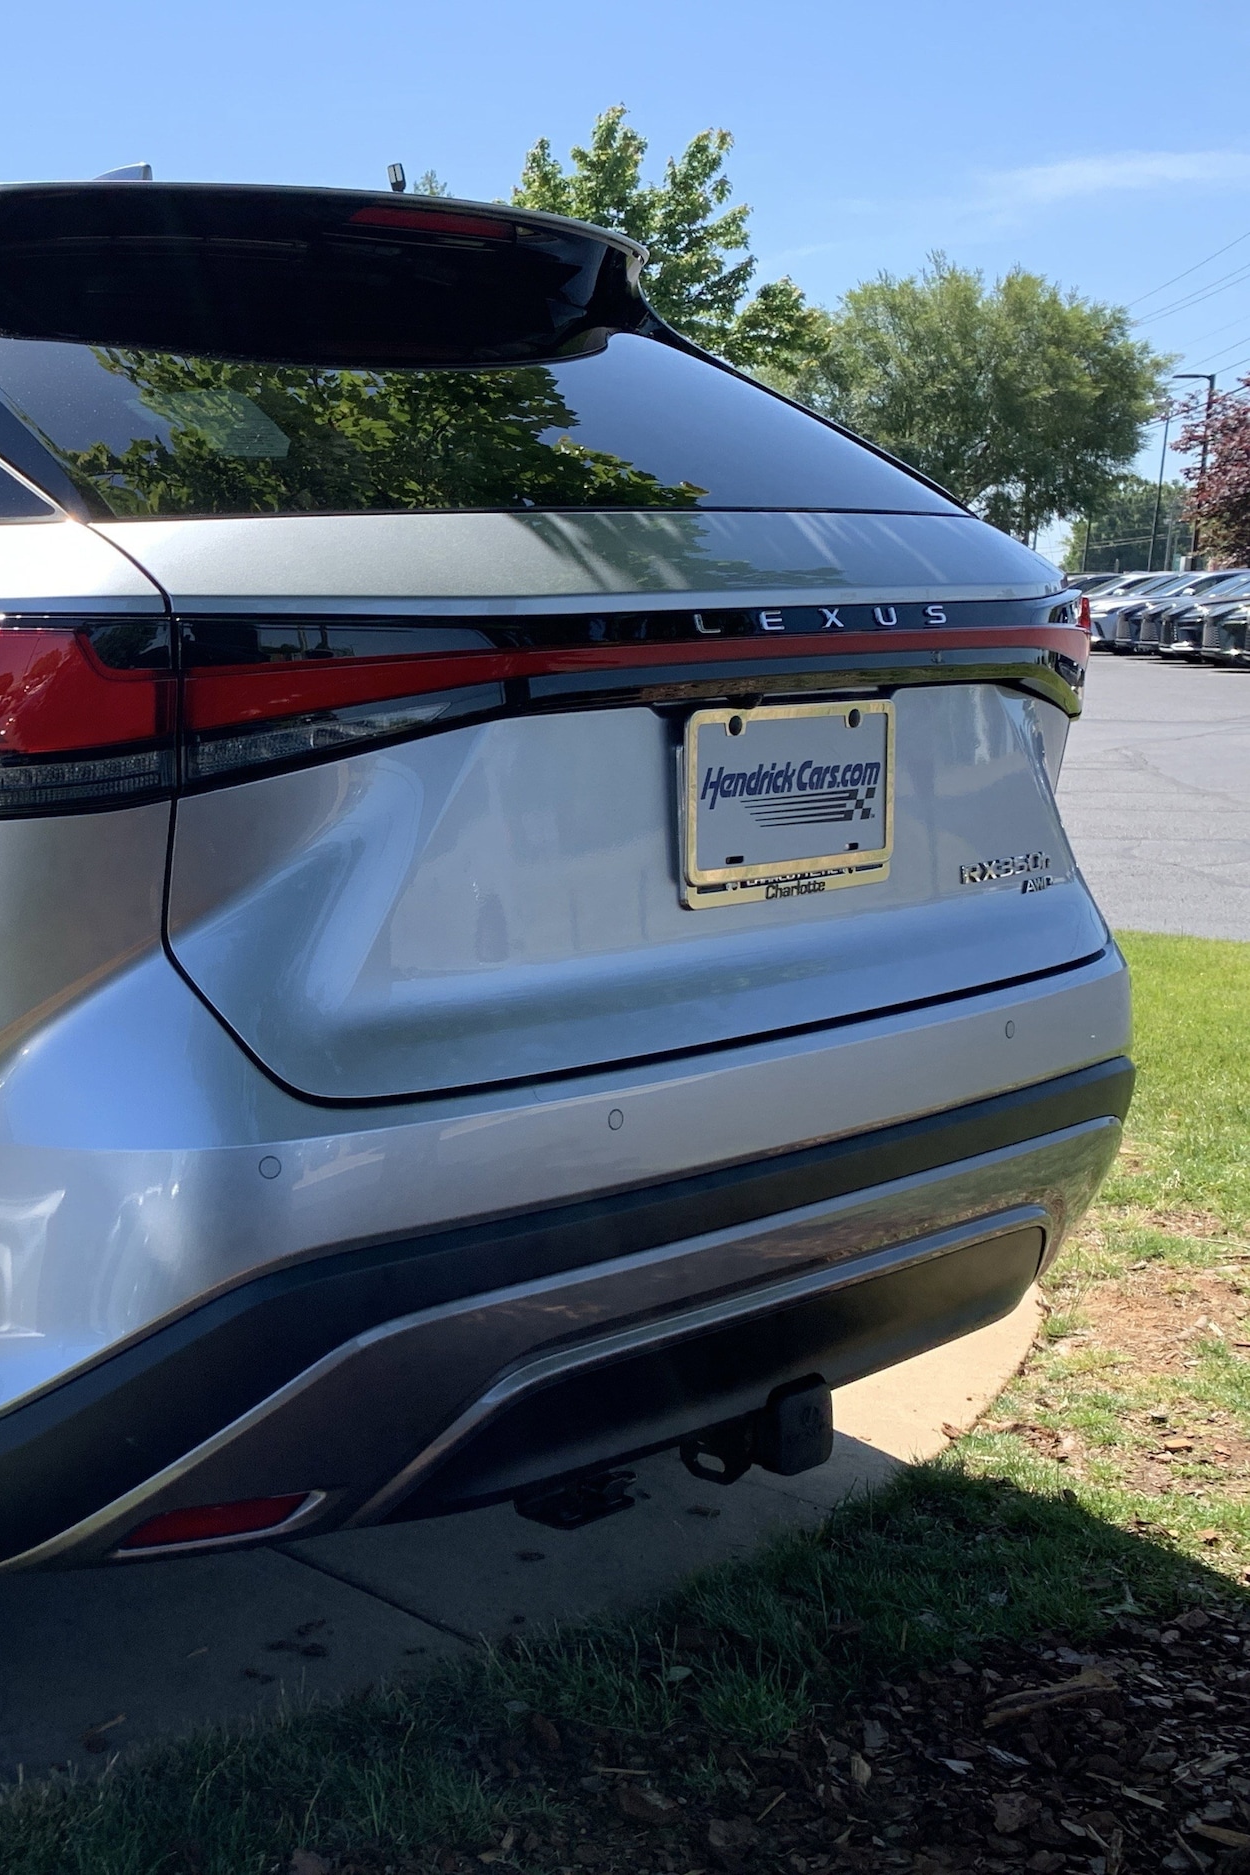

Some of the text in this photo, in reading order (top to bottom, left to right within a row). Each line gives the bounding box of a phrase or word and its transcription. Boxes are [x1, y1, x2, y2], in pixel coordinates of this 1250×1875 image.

[694, 605, 947, 634] LEXUS
[701, 760, 881, 810] HendrickCars.com
[765, 880, 826, 900] Charlotte
[1021, 875, 1053, 894] AWD
